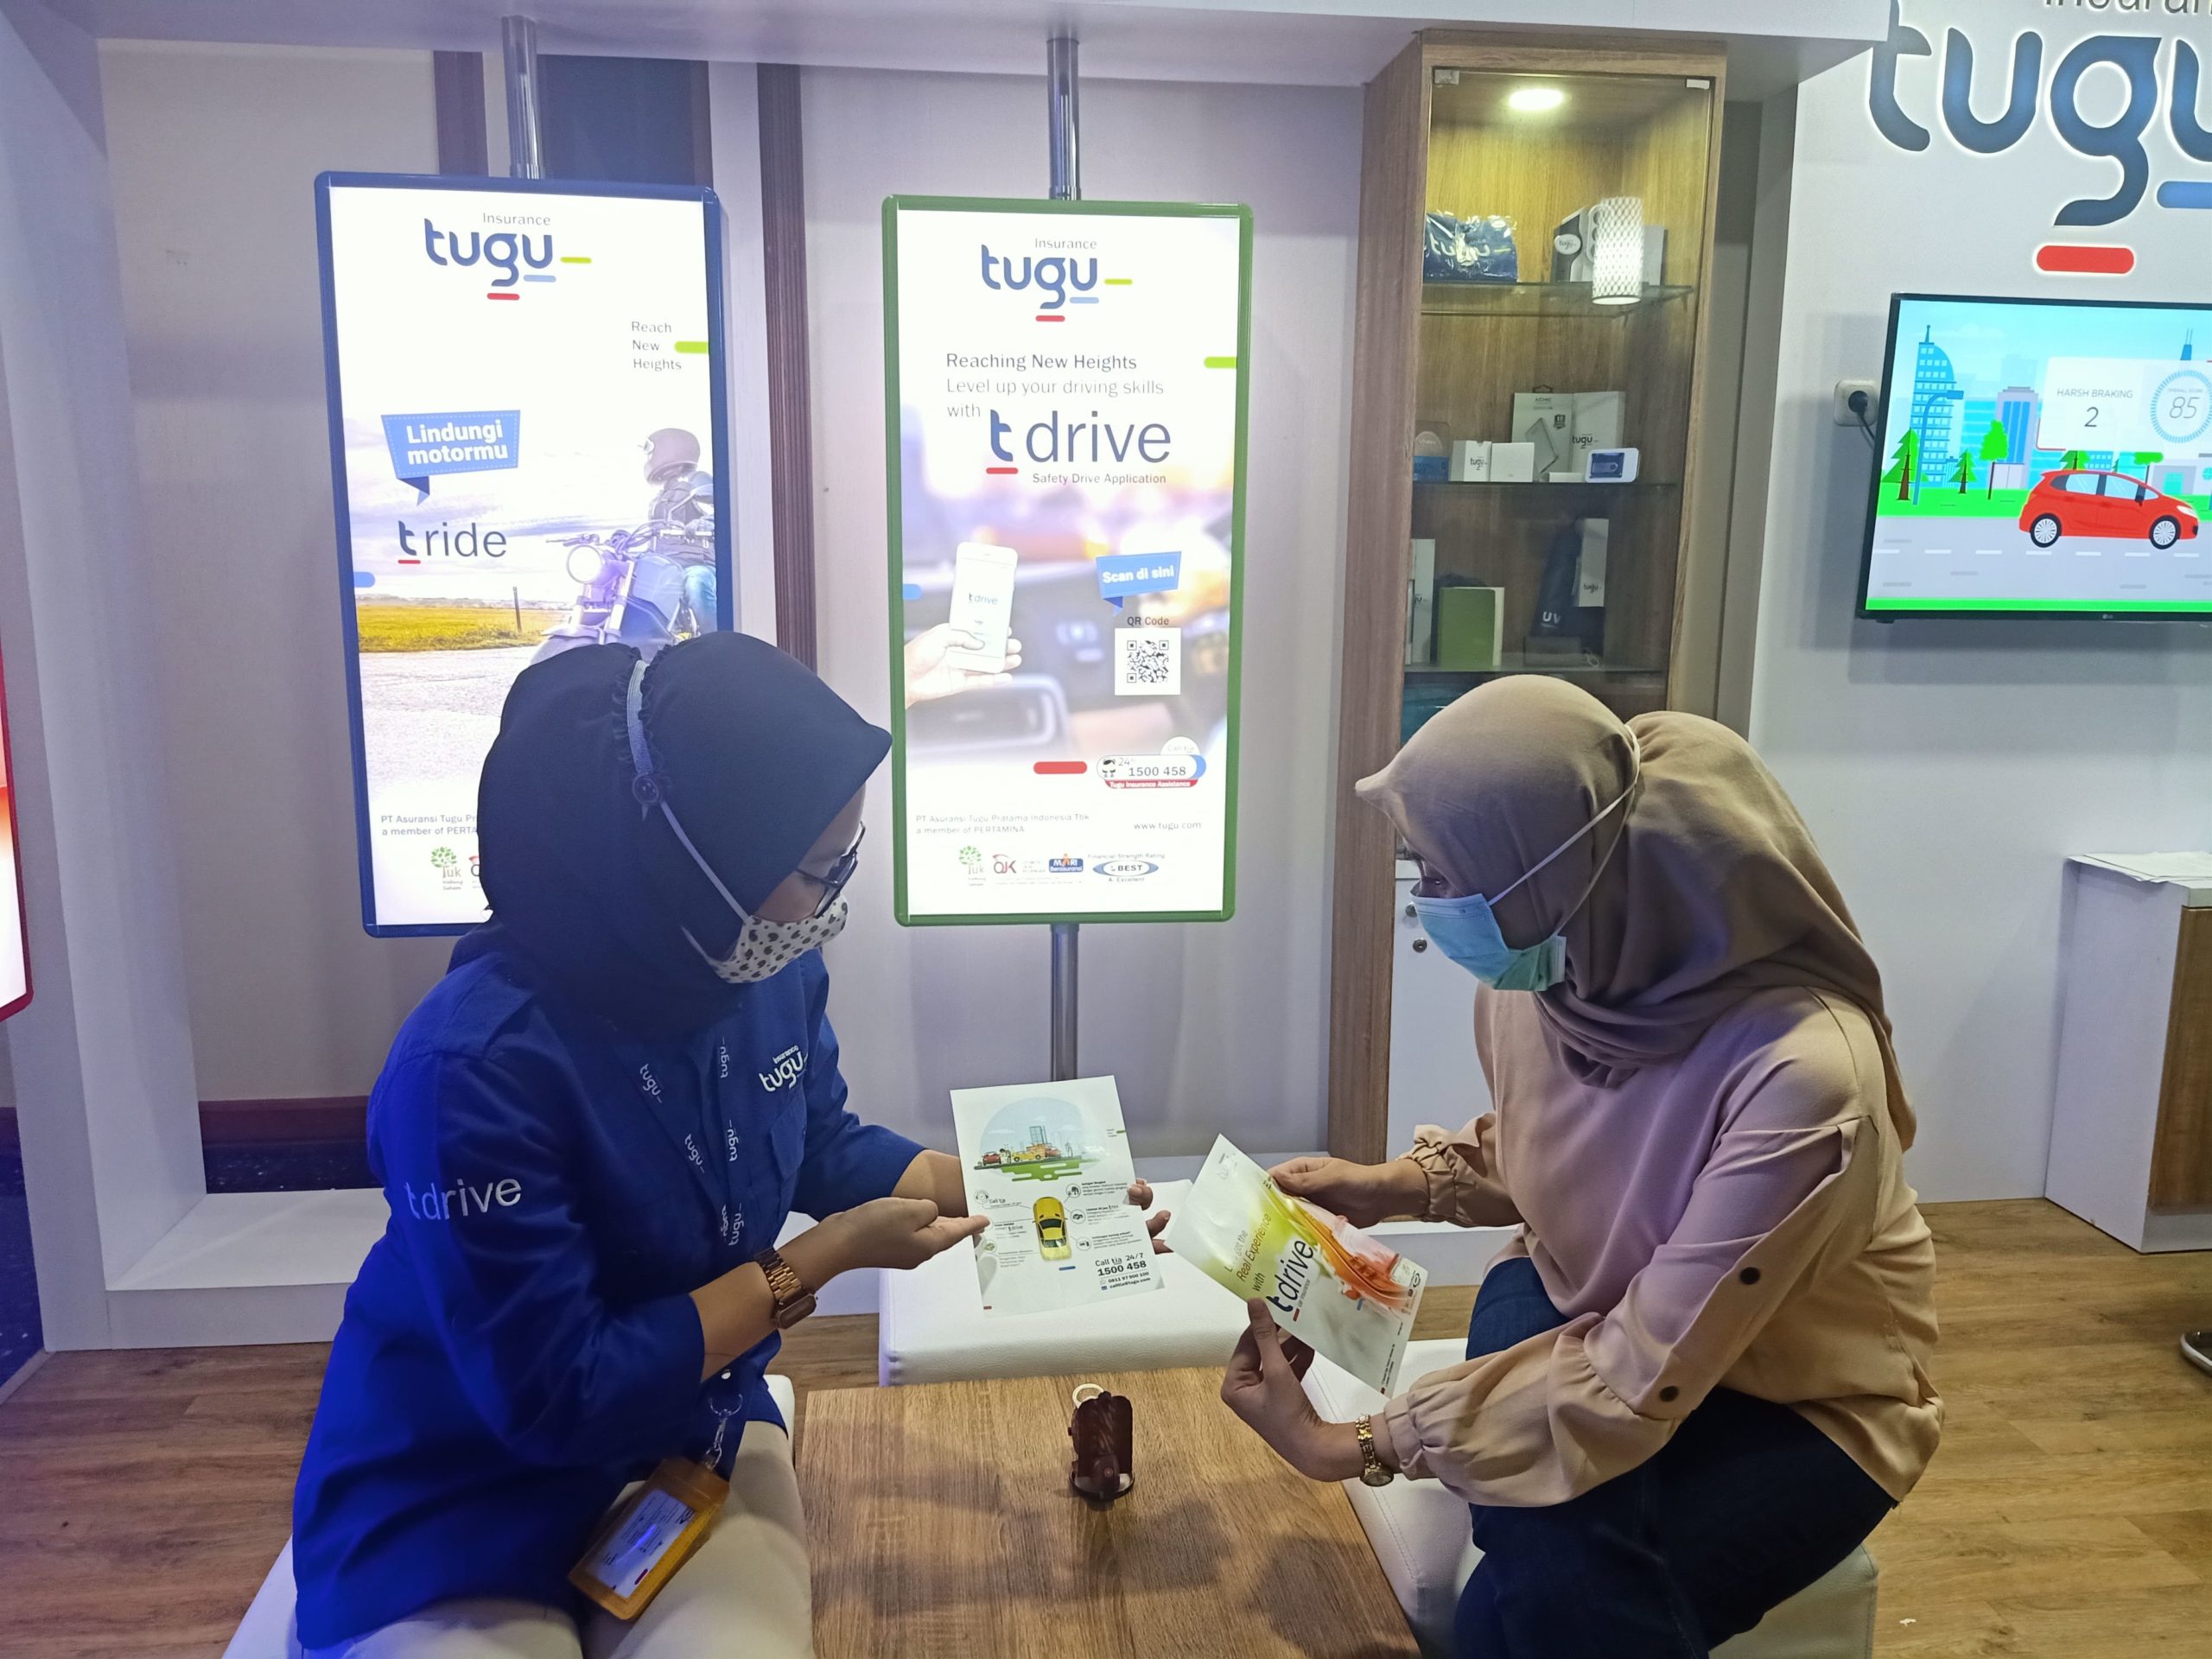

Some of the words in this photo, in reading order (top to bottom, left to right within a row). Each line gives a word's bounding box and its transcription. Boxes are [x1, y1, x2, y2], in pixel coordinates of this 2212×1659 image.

[483, 213, 551, 226] Insurance
[424, 218, 554, 287] tugu
[1035, 238, 1097, 250] Insurance
[981, 244, 1097, 309] tugu
[631, 321, 673, 334] Reach
[632, 340, 660, 352] New
[632, 358, 682, 372] Heights
[946, 353, 1027, 372] Reaching
[1032, 354, 1068, 369] New
[1073, 354, 1137, 372] Heights
[946, 378, 990, 393] Level
[996, 381, 1017, 397] up
[1022, 381, 1057, 397] your
[1063, 378, 1118, 397] driving
[1123, 379, 1164, 395] skills
[2056, 389, 2089, 397] HARSH
[2091, 390, 2133, 398] BRAKING
[947, 404, 981, 418] with
[2084, 406, 2099, 427] 2
[2169, 397, 2200, 419] 85
[406, 419, 504, 444] Lindungi
[1572, 435, 1593, 447] tugu
[407, 442, 508, 465] motormu
[1033, 473, 1068, 486] Safety
[1071, 473, 1100, 484] Drive
[1103, 473, 1166, 486] Application
[1103, 569, 1134, 584] Scan
[1136, 567, 1149, 581] di
[1151, 565, 1175, 579] sini
[1127, 616, 1141, 627] QR
[1144, 616, 1169, 626] Code
[1128, 766, 1159, 777] 1500
[1163, 766, 1186, 776] 458
[381, 815, 393, 823] PT
[396, 815, 437, 823] Asuransi
[441, 815, 463, 823] Tugu
[391, 827, 431, 836] member
[447, 826, 477, 835] PERTA
[639, 1063, 662, 1096] tugu
[759, 1051, 804, 1092] tugu
[684, 1133, 703, 1166] tugu
[728, 1128, 739, 1162] tugu
[1236, 1259, 1252, 1282] Real
[1245, 1213, 1272, 1262] Experience
[1095, 1258, 1110, 1267] Call
[1097, 1265, 1124, 1276] 1500
[1127, 1260, 1147, 1270] 458
[1252, 1272, 1266, 1293] with
